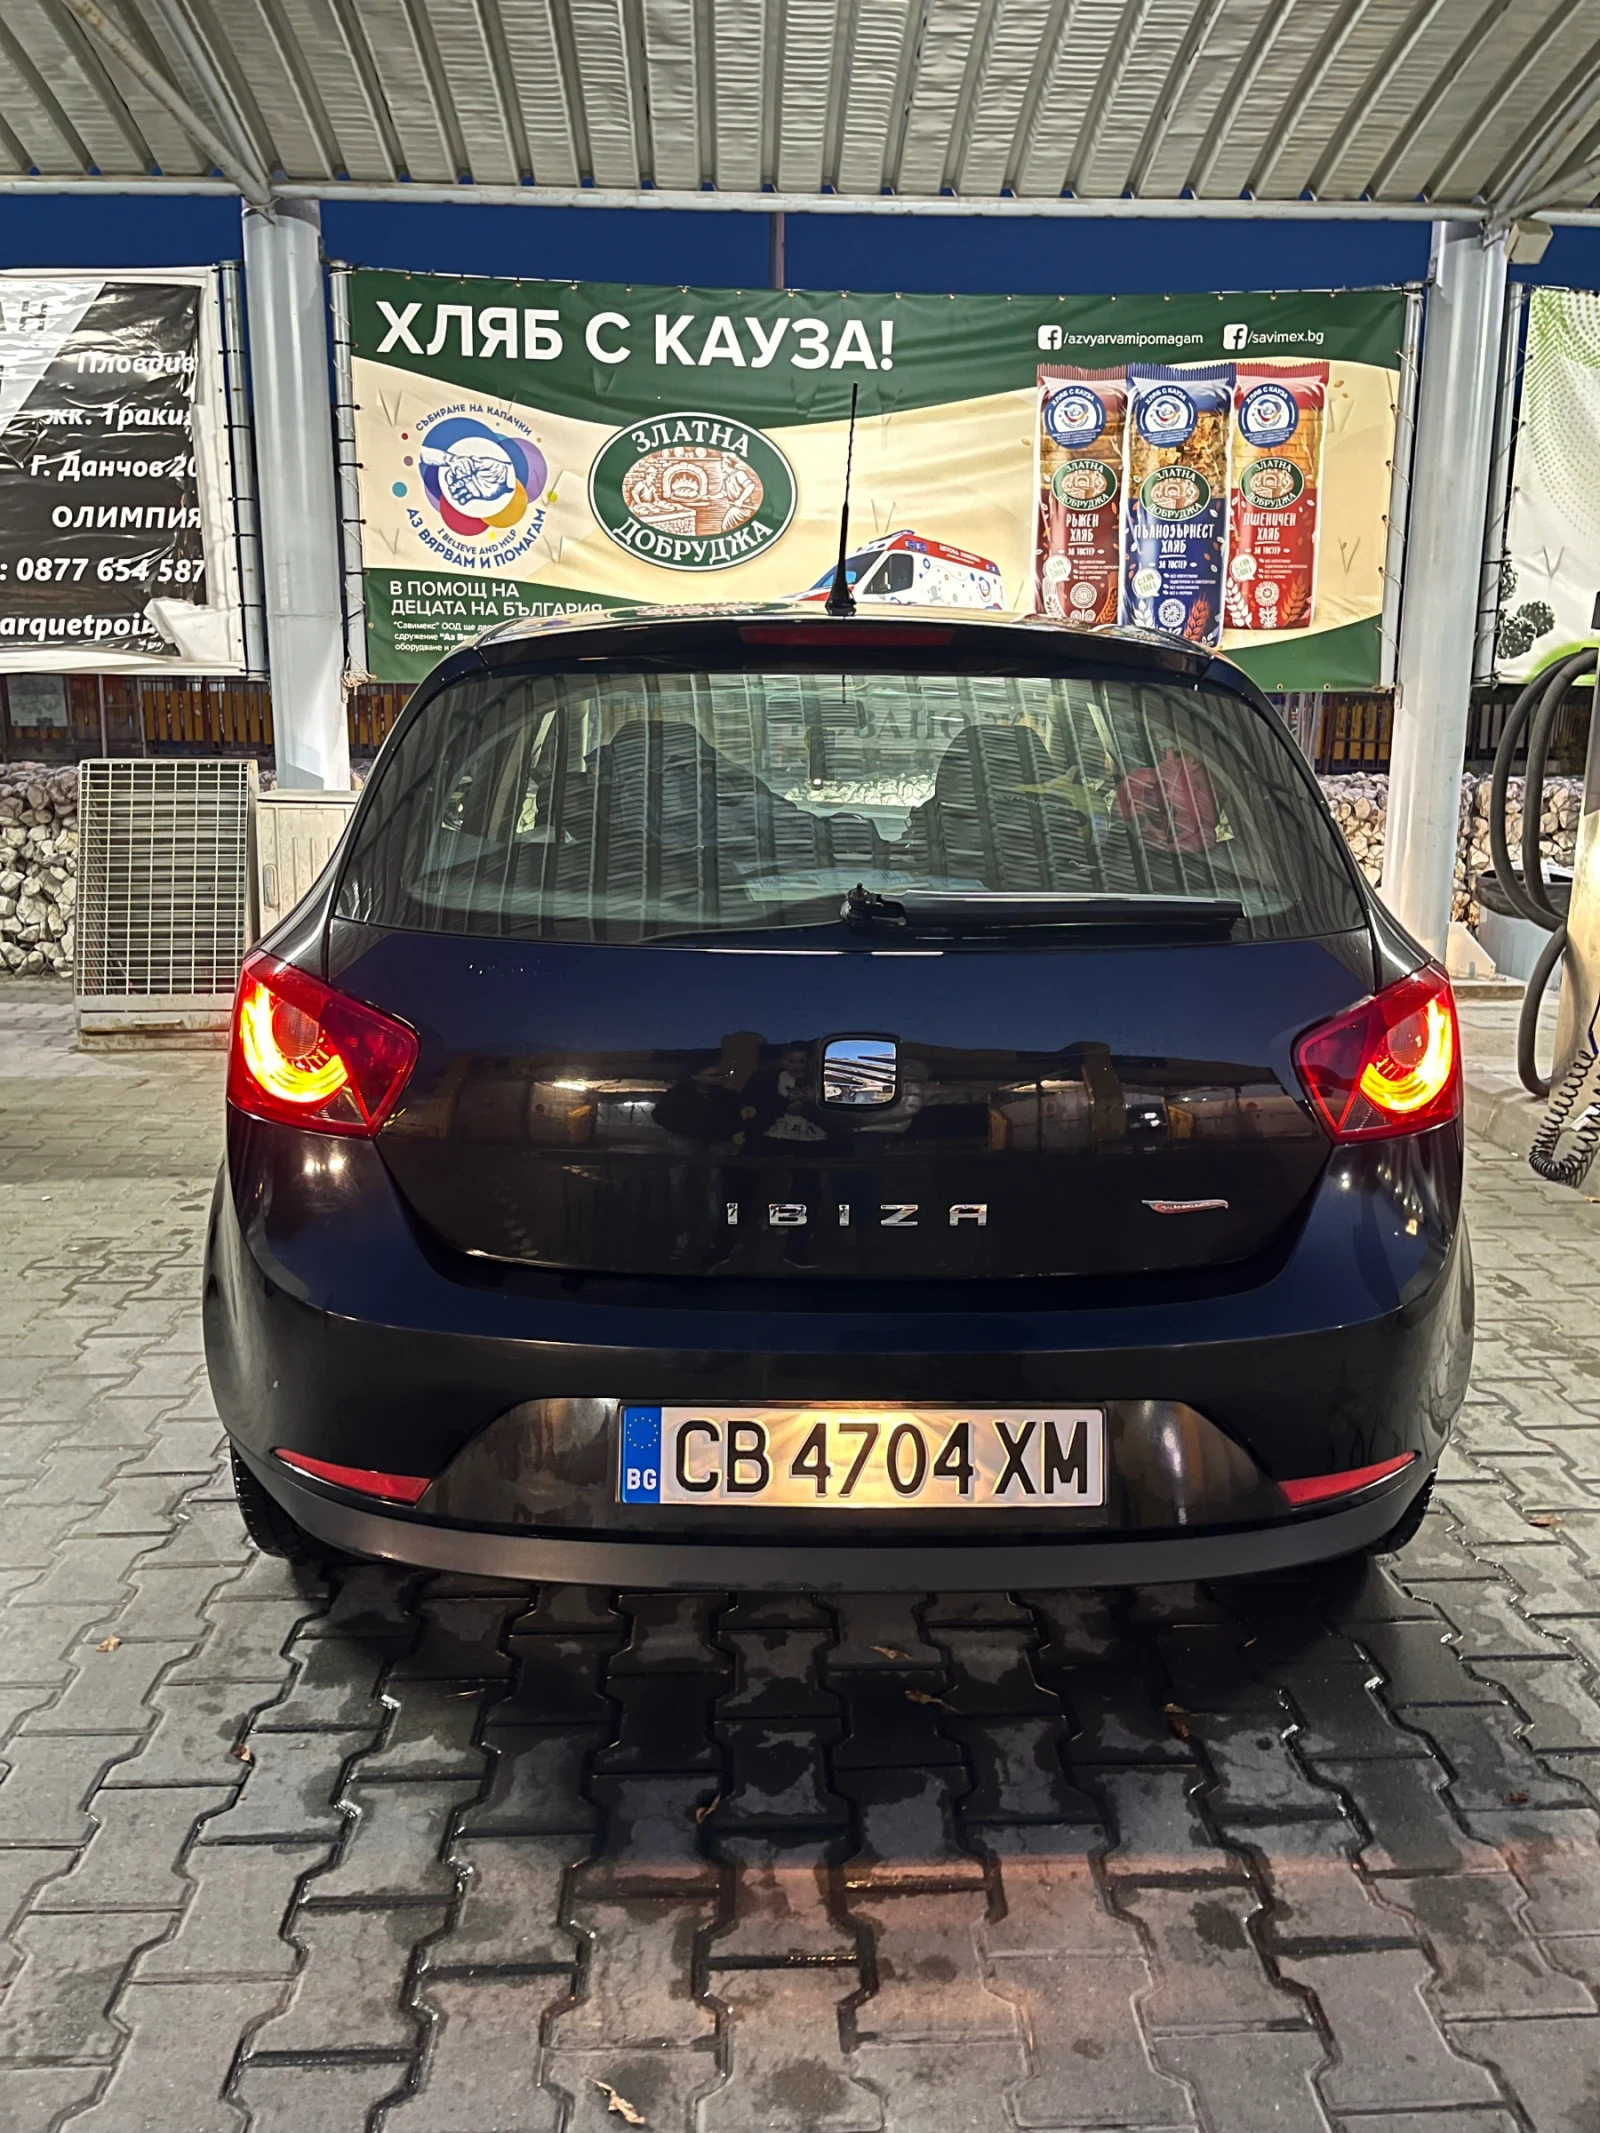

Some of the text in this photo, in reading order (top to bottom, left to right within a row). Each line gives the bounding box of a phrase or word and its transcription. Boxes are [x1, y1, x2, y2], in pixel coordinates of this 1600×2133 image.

[375, 300, 894, 371] ХЛЯБ С КАУЗА!
[1247, 330, 1325, 345] /savimex.bg
[77, 350, 195, 374] Пловдив
[415, 403, 533, 436] СЪБИРАНЕ НА КАПАЧКИ
[631, 420, 750, 458] ЗЛАТНА
[57, 455, 161, 482] Данчов
[1065, 461, 1104, 474] ЗЛАТНА
[1155, 468, 1196, 482] ЗЛАТНА
[1253, 459, 1292, 473] ЗЛАТНА
[52, 505, 201, 529] ОЛИМПИЯ
[1065, 513, 1099, 528] РЪЖЕН
[1243, 512, 1297, 527] ПШЕНИЧЕН
[406, 508, 546, 569] АЗ ВЯРВАМ И ПОМАГАМ
[442, 531, 477, 555] BELIEVE
[479, 544, 499, 555] AND
[500, 529, 517, 548] HELP
[612, 516, 774, 565] ДОБРУДЖА
[1257, 527, 1280, 541] ХЛЯБ
[1161, 540, 1187, 554] ХЛЯБ
[15, 557, 89, 582] 0877
[97, 557, 150, 582] 654
[157, 558, 205, 583] 587
[389, 580, 520, 599] В ПОМОЩ НА
[391, 599, 467, 617] ДЕЦАТА
[471, 601, 500, 616] НА
[441, 622, 462, 631] ООД
[394, 633, 439, 642] сдружение
[394, 643, 442, 652] оборудване
[726, 1202, 988, 1227] IBIZA
[676, 1419, 1089, 1496] CB 4704 XM
[626, 1469, 657, 1490] BG
